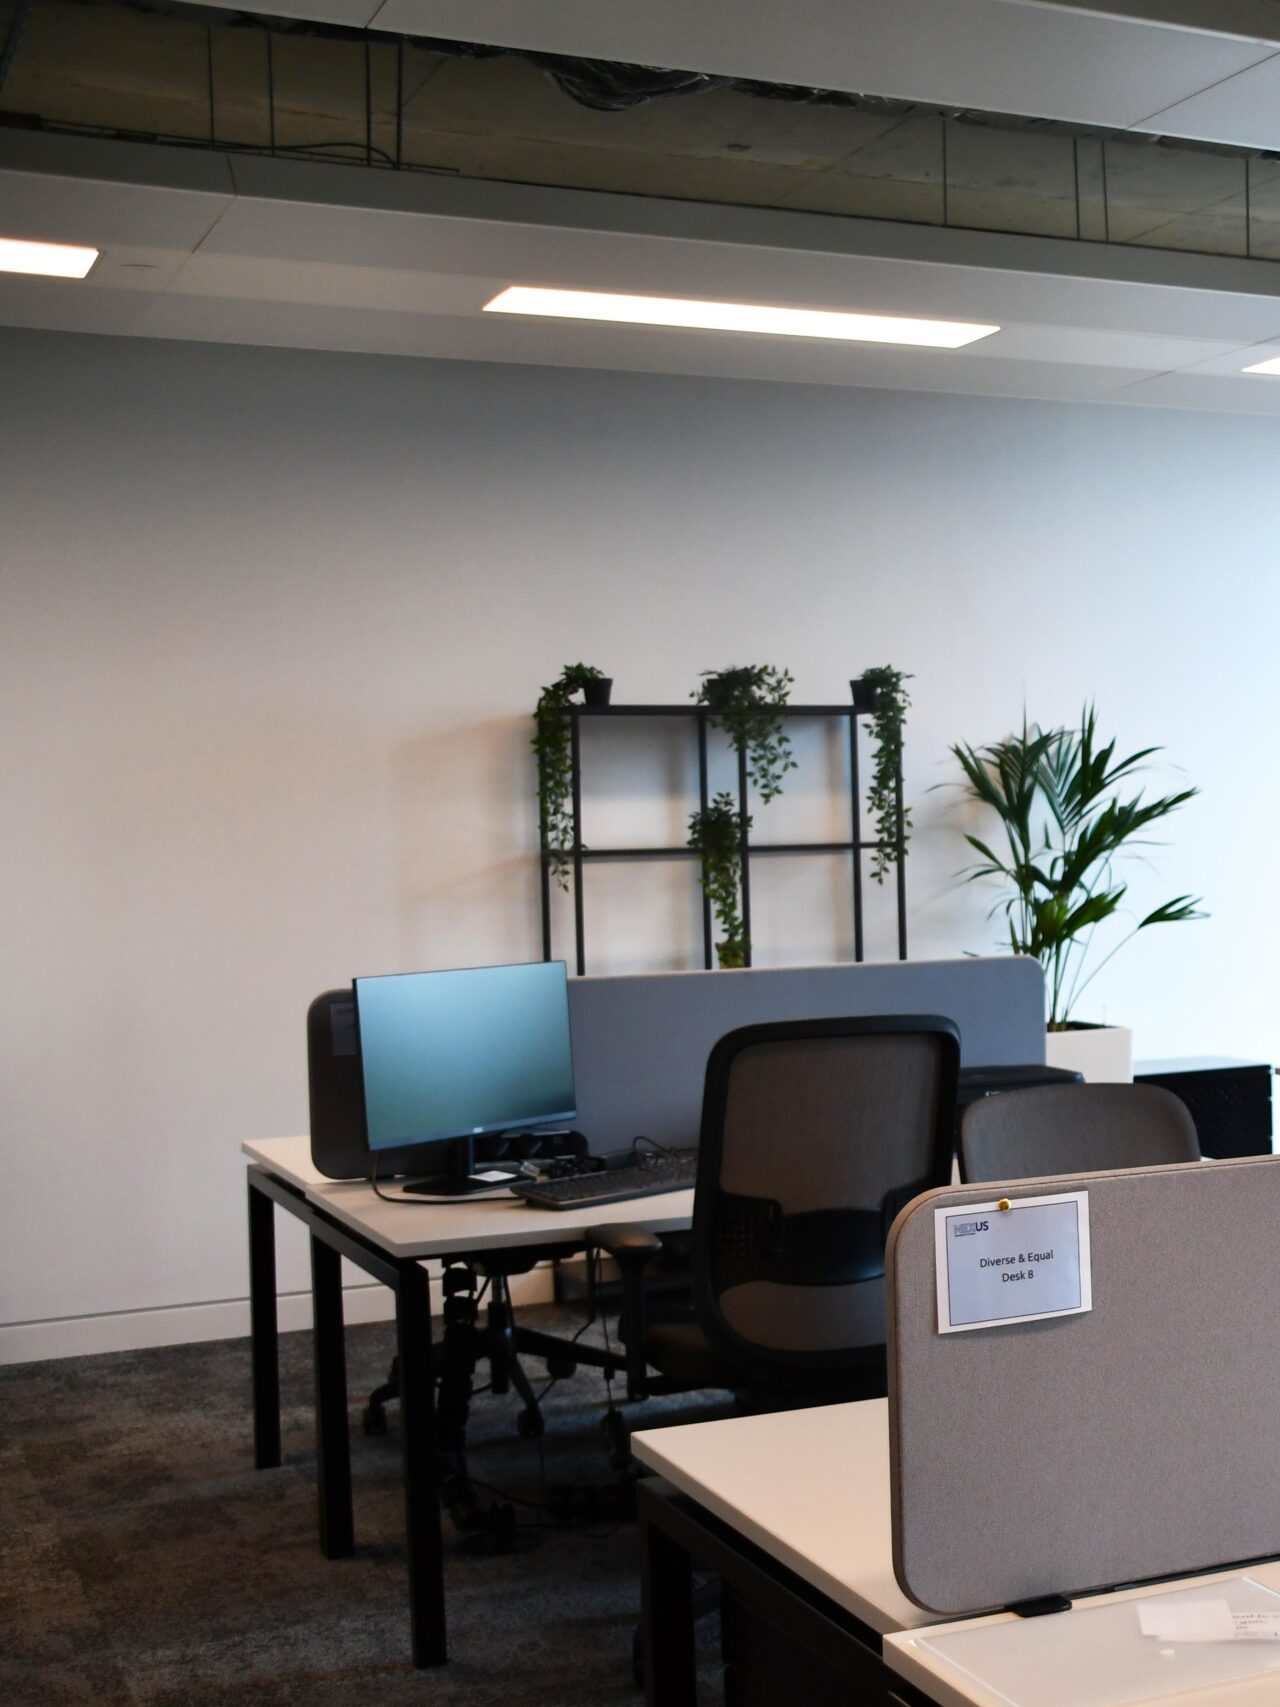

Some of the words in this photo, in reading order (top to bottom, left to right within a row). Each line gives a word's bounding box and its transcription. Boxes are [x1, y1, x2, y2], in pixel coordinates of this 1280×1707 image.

[979, 1256, 1016, 1268] Diverse
[1018, 1253, 1026, 1264] &
[1027, 1249, 1054, 1263] Equal
[1002, 1270, 1026, 1283] Desk
